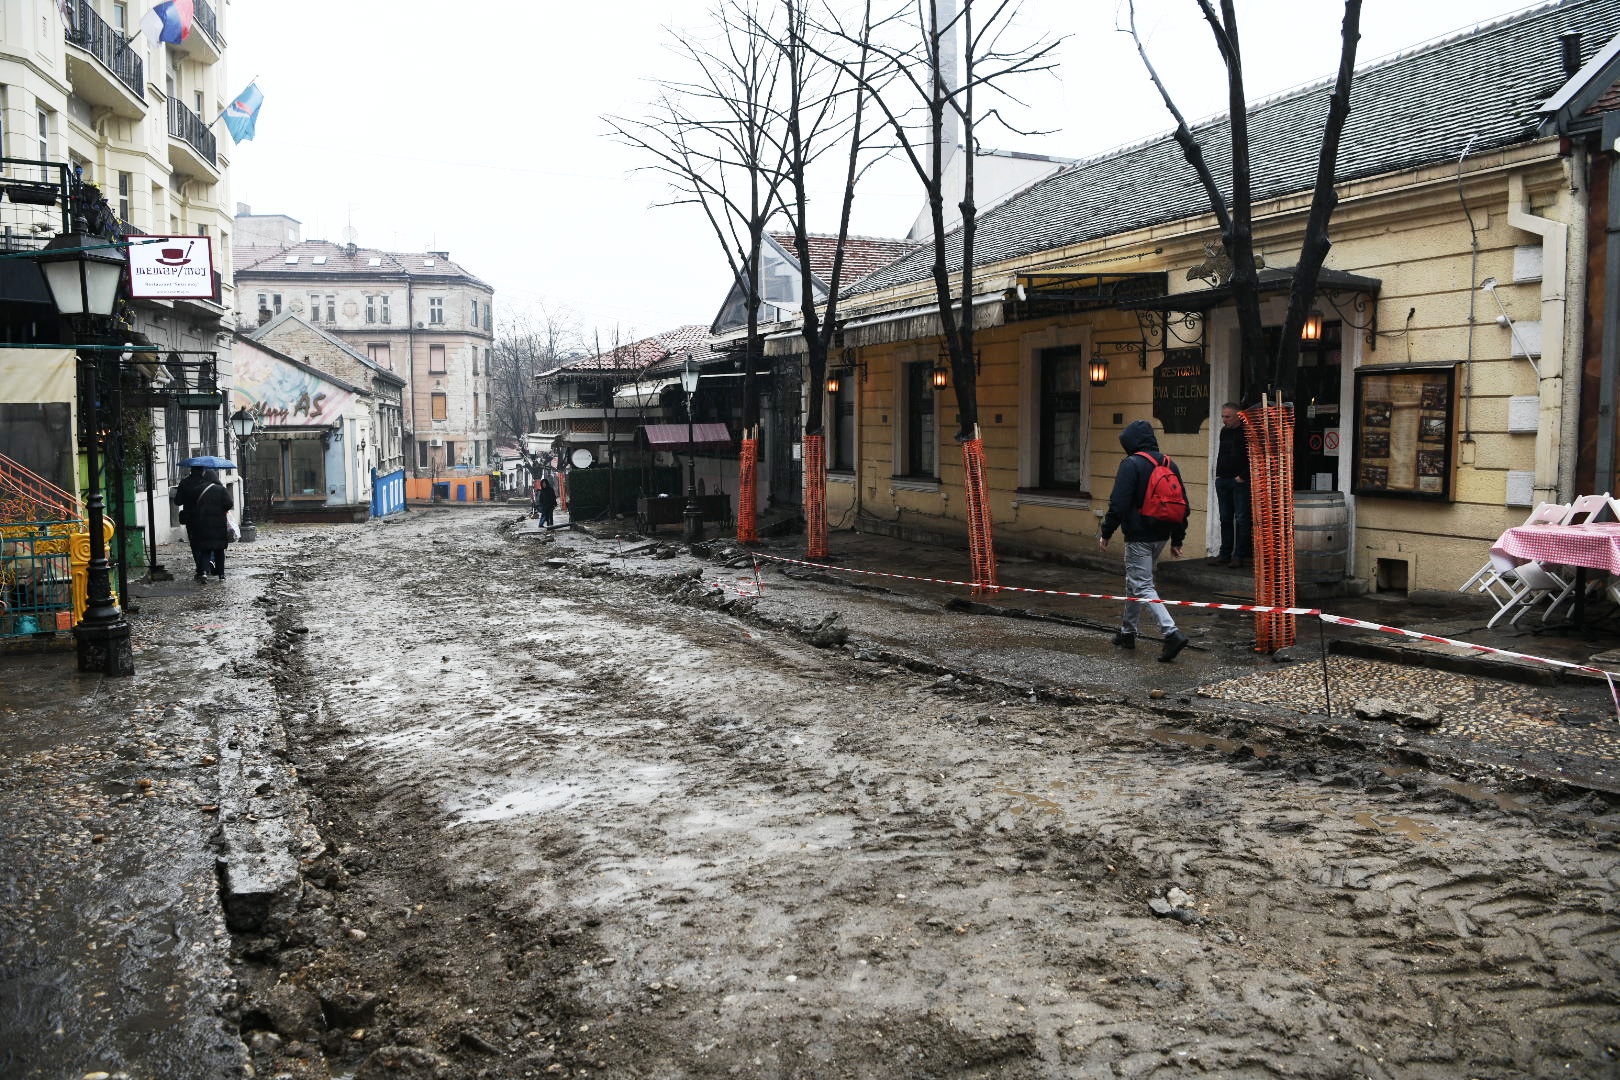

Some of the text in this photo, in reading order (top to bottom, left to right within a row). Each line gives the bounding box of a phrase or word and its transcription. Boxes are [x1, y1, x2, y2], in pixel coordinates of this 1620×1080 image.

[1161, 365, 1200, 377] RESTORAN
[1172, 384, 1208, 399] JELENA
[293, 392, 327, 417] AS
[334, 433, 343, 442] 27
